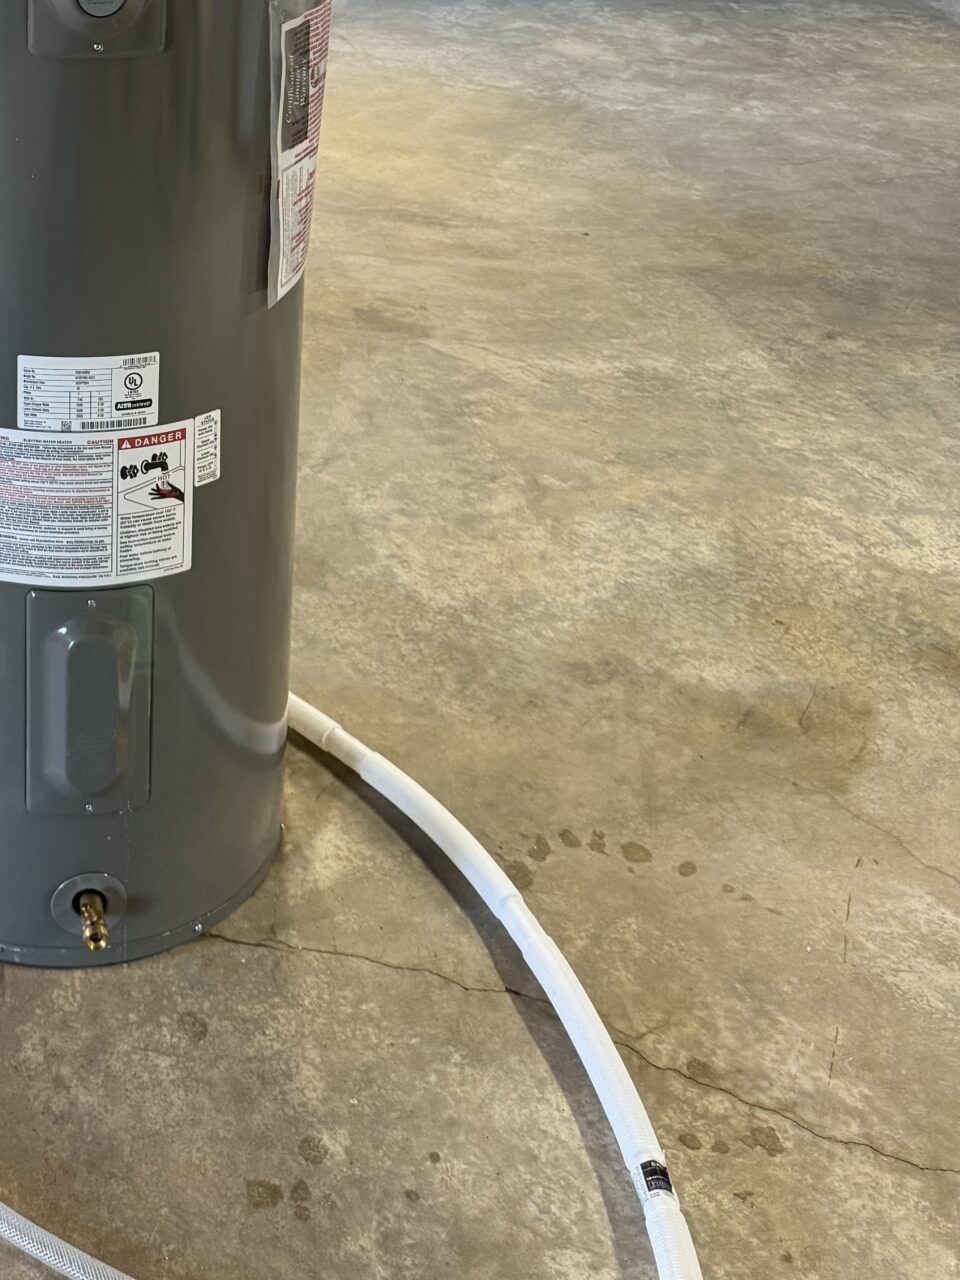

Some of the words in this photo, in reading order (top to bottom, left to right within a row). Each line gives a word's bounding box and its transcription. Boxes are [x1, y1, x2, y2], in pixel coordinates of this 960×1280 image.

[286, 68, 294, 123] Certificate
[129, 377, 138, 386] UL
[135, 431, 182, 447] DANGER
